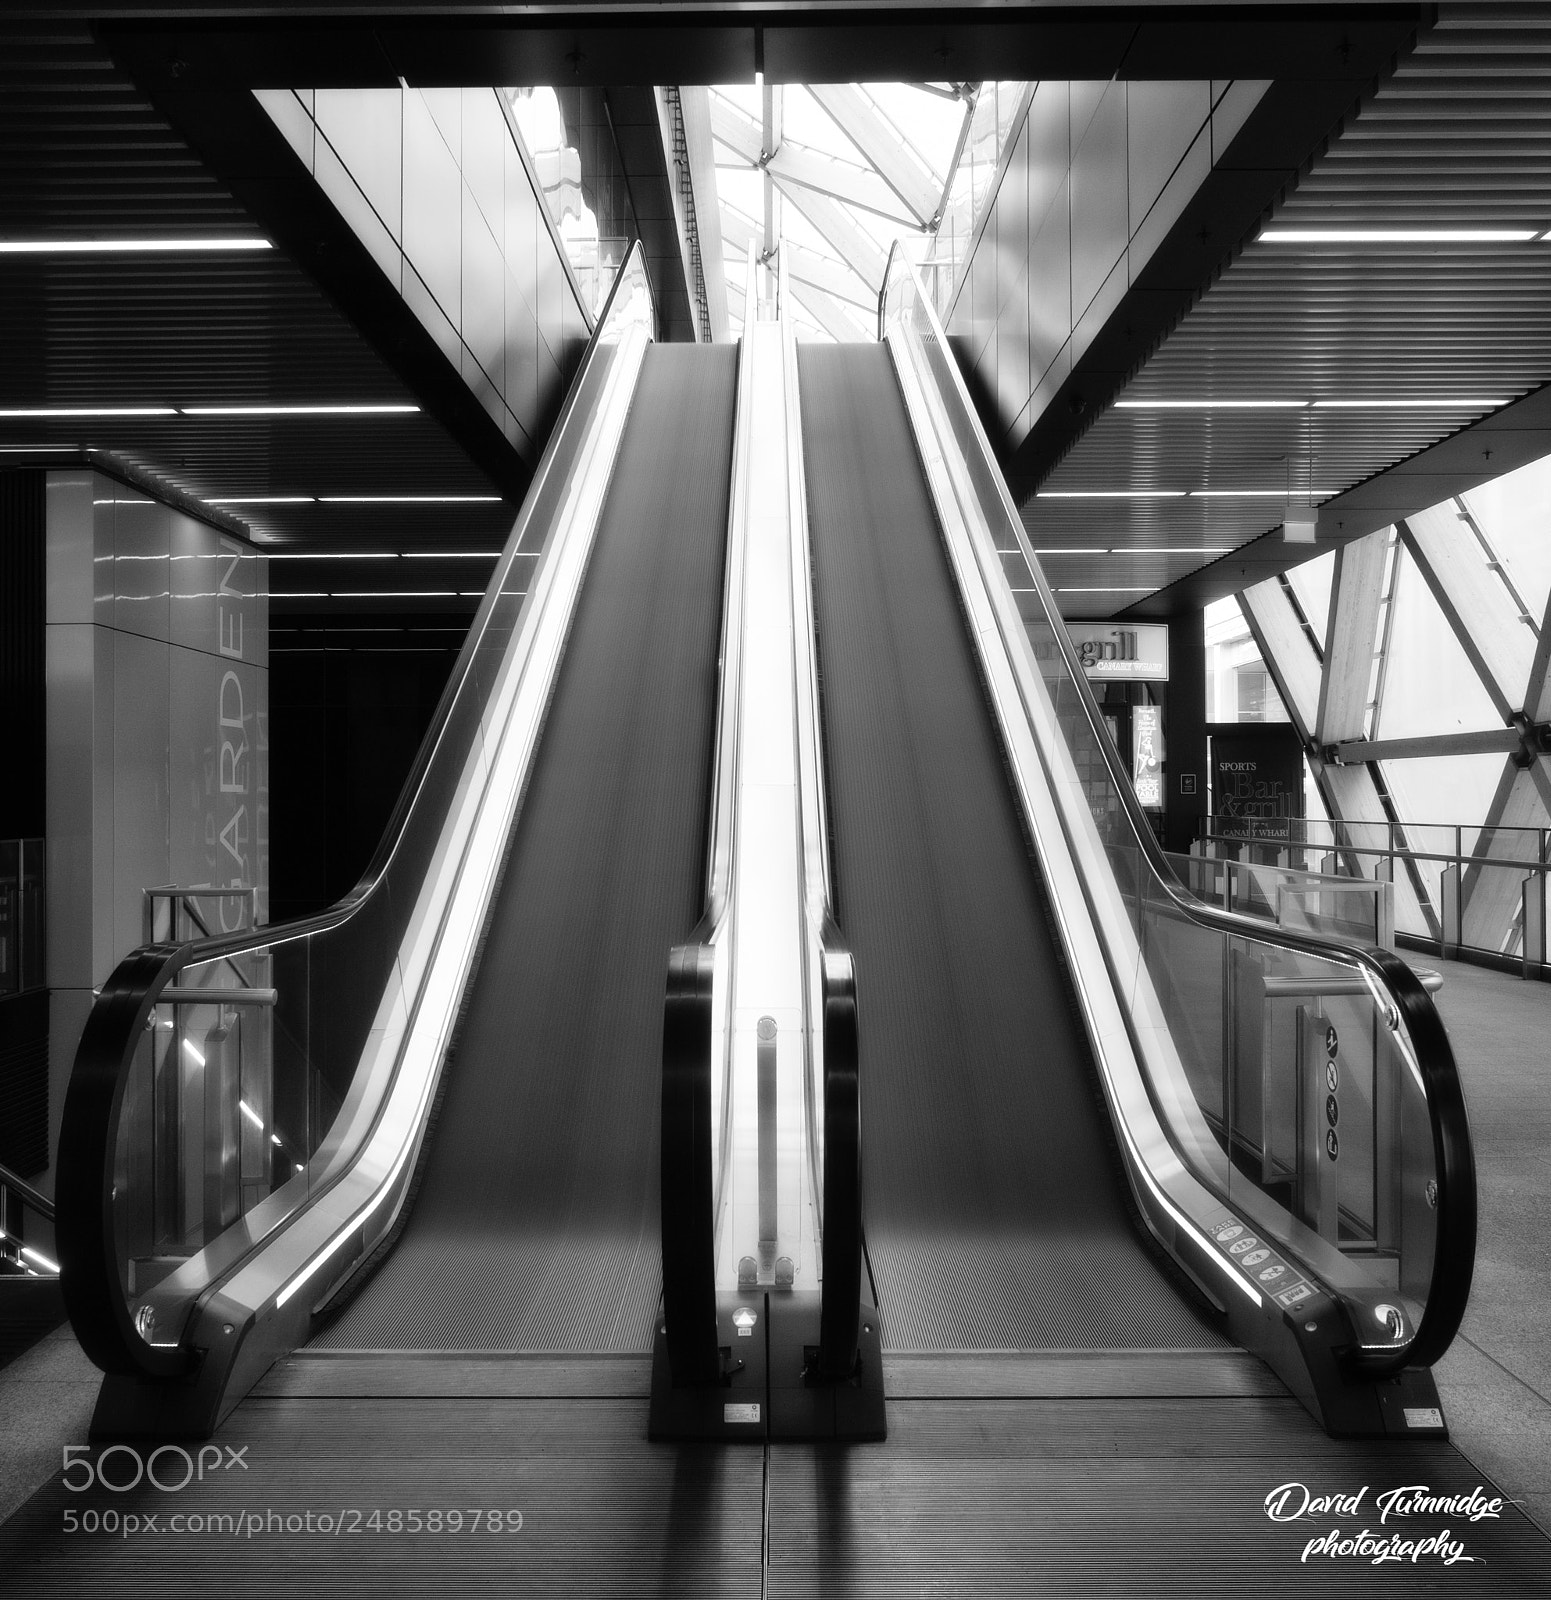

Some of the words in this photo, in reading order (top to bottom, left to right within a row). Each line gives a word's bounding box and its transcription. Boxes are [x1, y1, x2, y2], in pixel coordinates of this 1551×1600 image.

[1096, 661, 1132, 671] CANARY
[1133, 662, 1163, 671] WHARF
[219, 538, 243, 933] GARDEN
[1219, 762, 1257, 771] SPORTS
[1231, 772, 1283, 799] Bar
